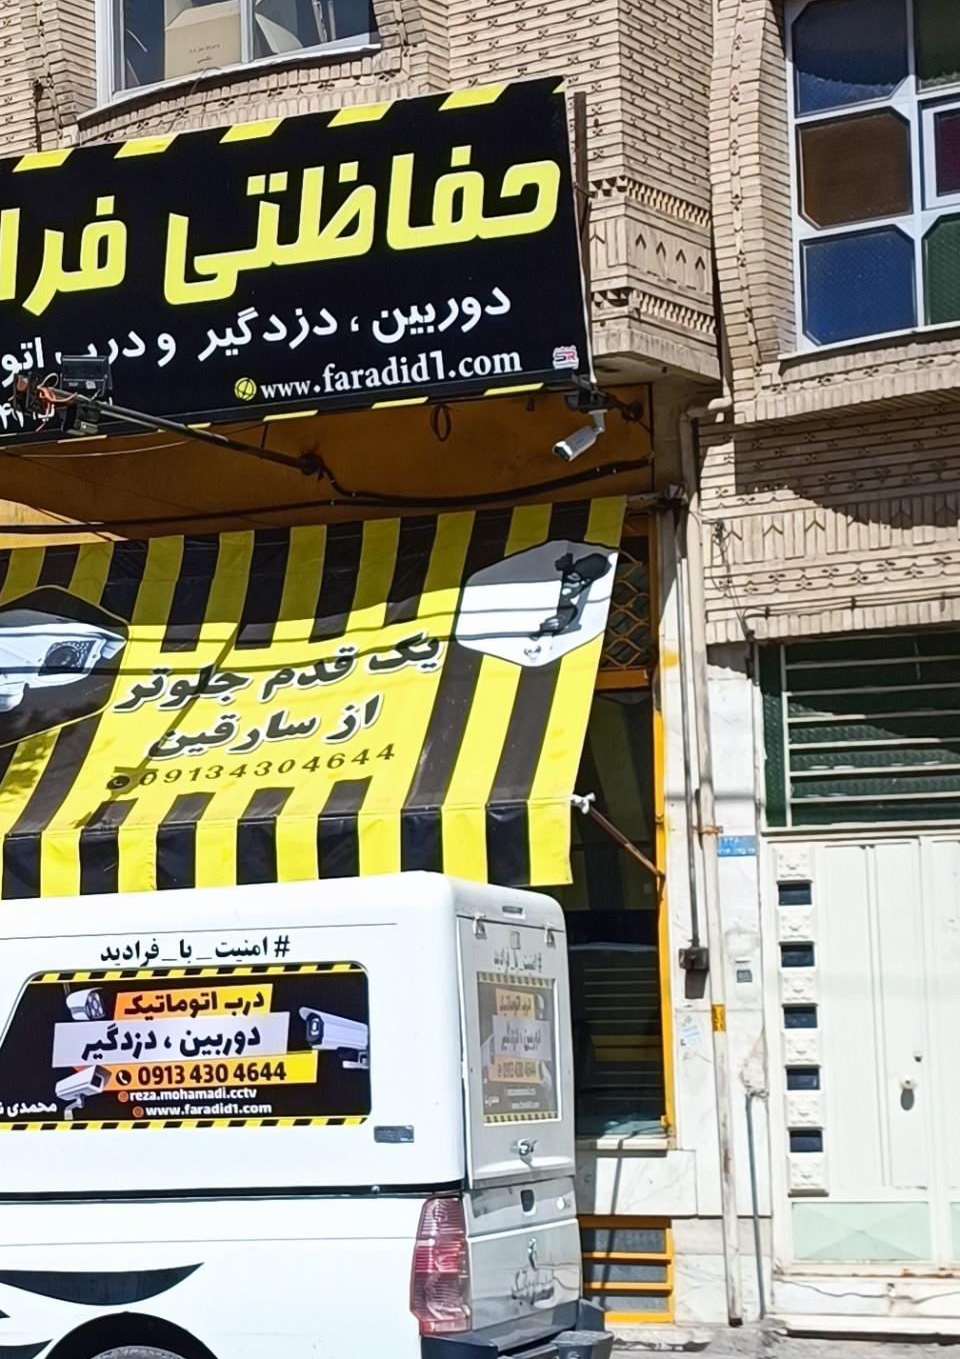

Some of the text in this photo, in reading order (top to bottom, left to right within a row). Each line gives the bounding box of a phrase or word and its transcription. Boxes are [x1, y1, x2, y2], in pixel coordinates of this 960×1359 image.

[162, 144, 561, 305] حفاظتی
[372, 286, 511, 344] دوربین
[157, 332, 177, 368] و
[197, 306, 338, 362] دزدگیر
[260, 350, 523, 400] www.faradid1.com
[114, 631, 442, 711] یک قدم جلوتر
[147, 693, 382, 759] از سارقین
[138, 743, 395, 786] 09134304644
[124, 991, 265, 1021] درب اتوماتیک
[81, 1024, 157, 1061] دزدگیر
[179, 1026, 261, 1058] دوربین
[138, 1061, 287, 1086] 0913 430 4644
[6, 1101, 58, 1117] محمدی
[129, 1088, 257, 1102] reza.mohamadi.cctv
[146, 1101, 272, 1116] www.faradid1.com
